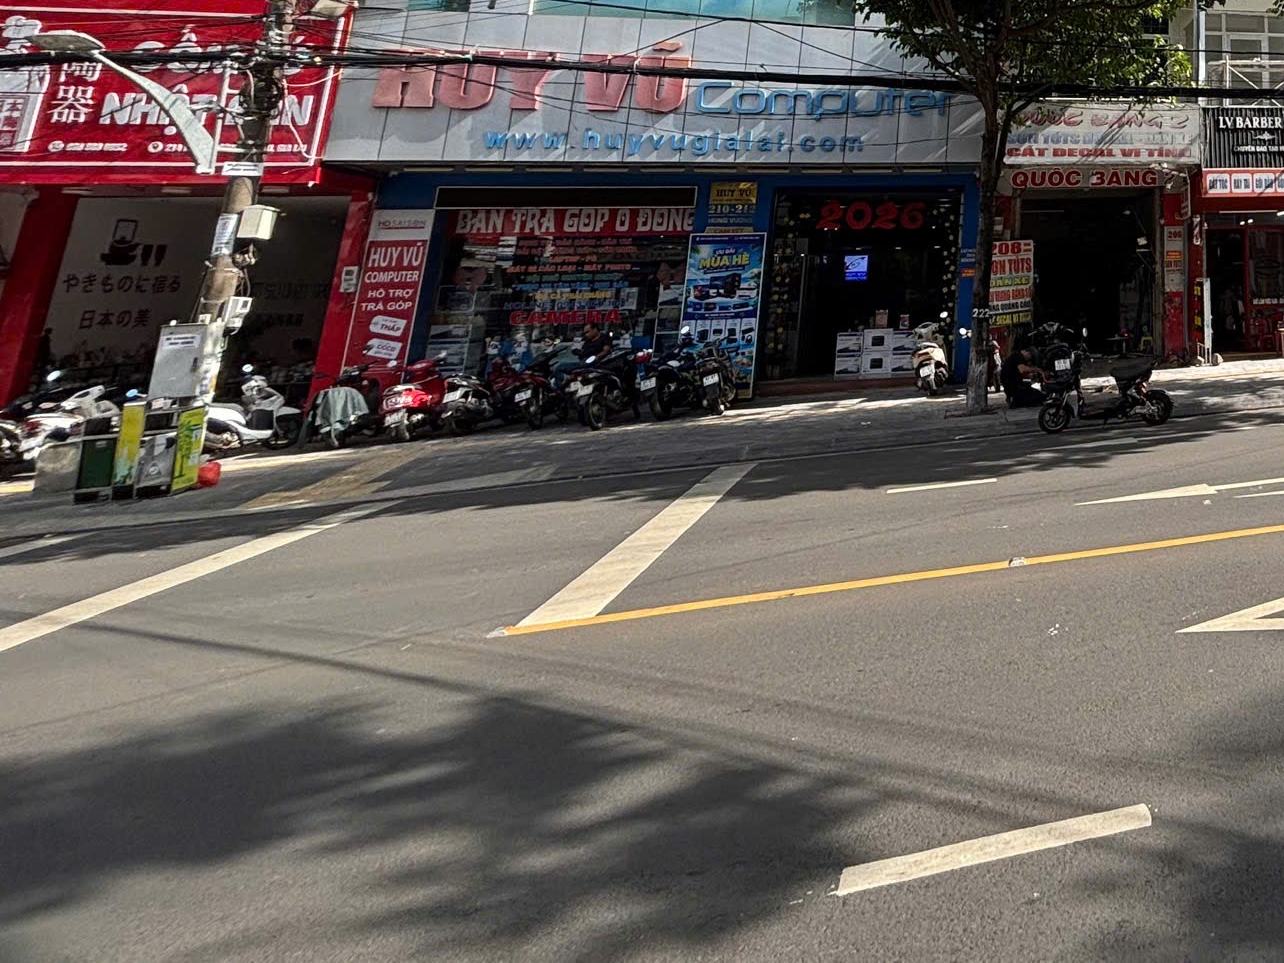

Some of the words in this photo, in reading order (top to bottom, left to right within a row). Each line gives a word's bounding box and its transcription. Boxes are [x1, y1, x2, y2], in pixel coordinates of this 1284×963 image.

[373, 48, 560, 112] HUY
[581, 41, 691, 113] VŨ
[696, 81, 951, 121] Computer
[1218, 116, 1234, 128] LV
[1235, 116, 1283, 129] BARBER
[1052, 147, 1116, 157] DECAL
[716, 189, 736, 197] HUY
[815, 199, 928, 230] 2026
[368, 246, 401, 268] HUY
[62, 273, 181, 294] やきものに宿る
[364, 271, 420, 283] COMPUTER
[78, 308, 152, 330] 日本の美
[509, 309, 621, 325] CAMERA
[972, 308, 990, 318] 222
